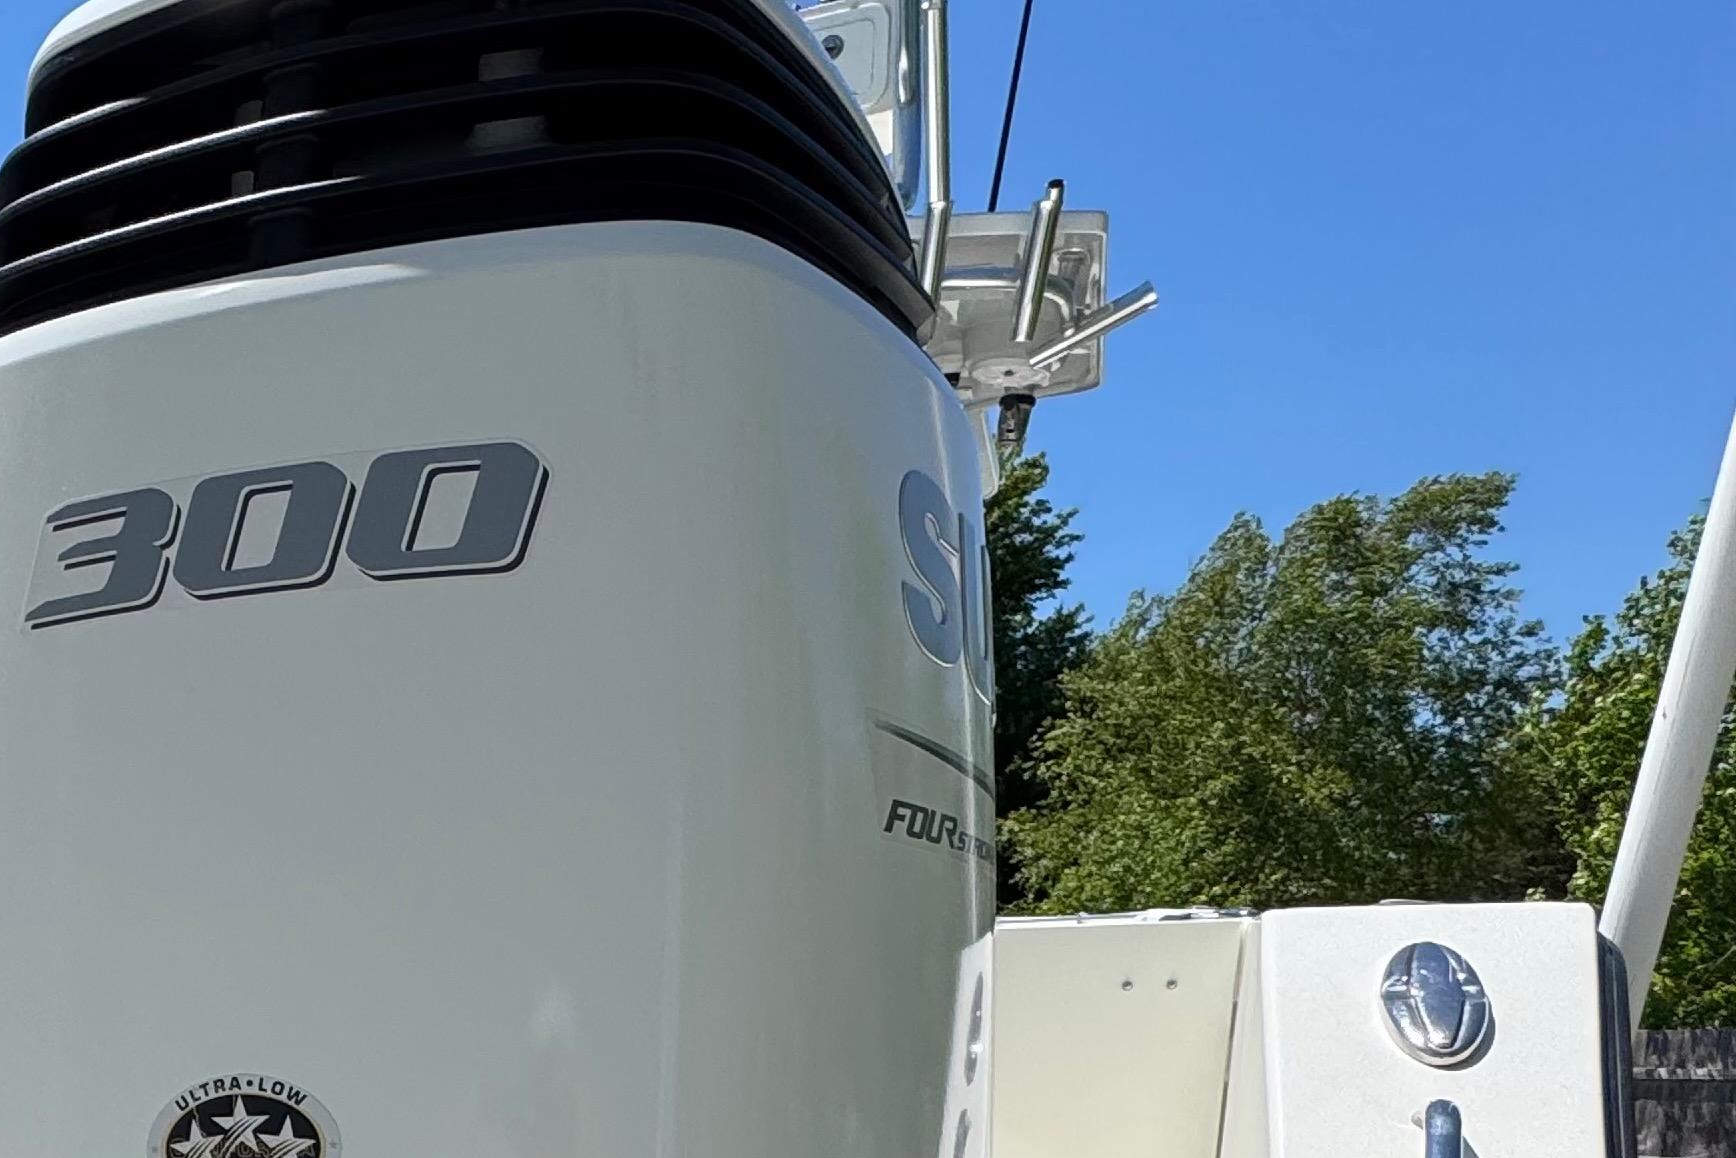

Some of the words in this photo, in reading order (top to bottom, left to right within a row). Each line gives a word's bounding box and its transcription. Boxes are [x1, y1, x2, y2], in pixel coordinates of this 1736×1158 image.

[25, 442, 550, 630] 300
[883, 799, 958, 849] FOUR
[175, 1076, 242, 1112] ULTRA
[259, 1077, 308, 1106] LOW
